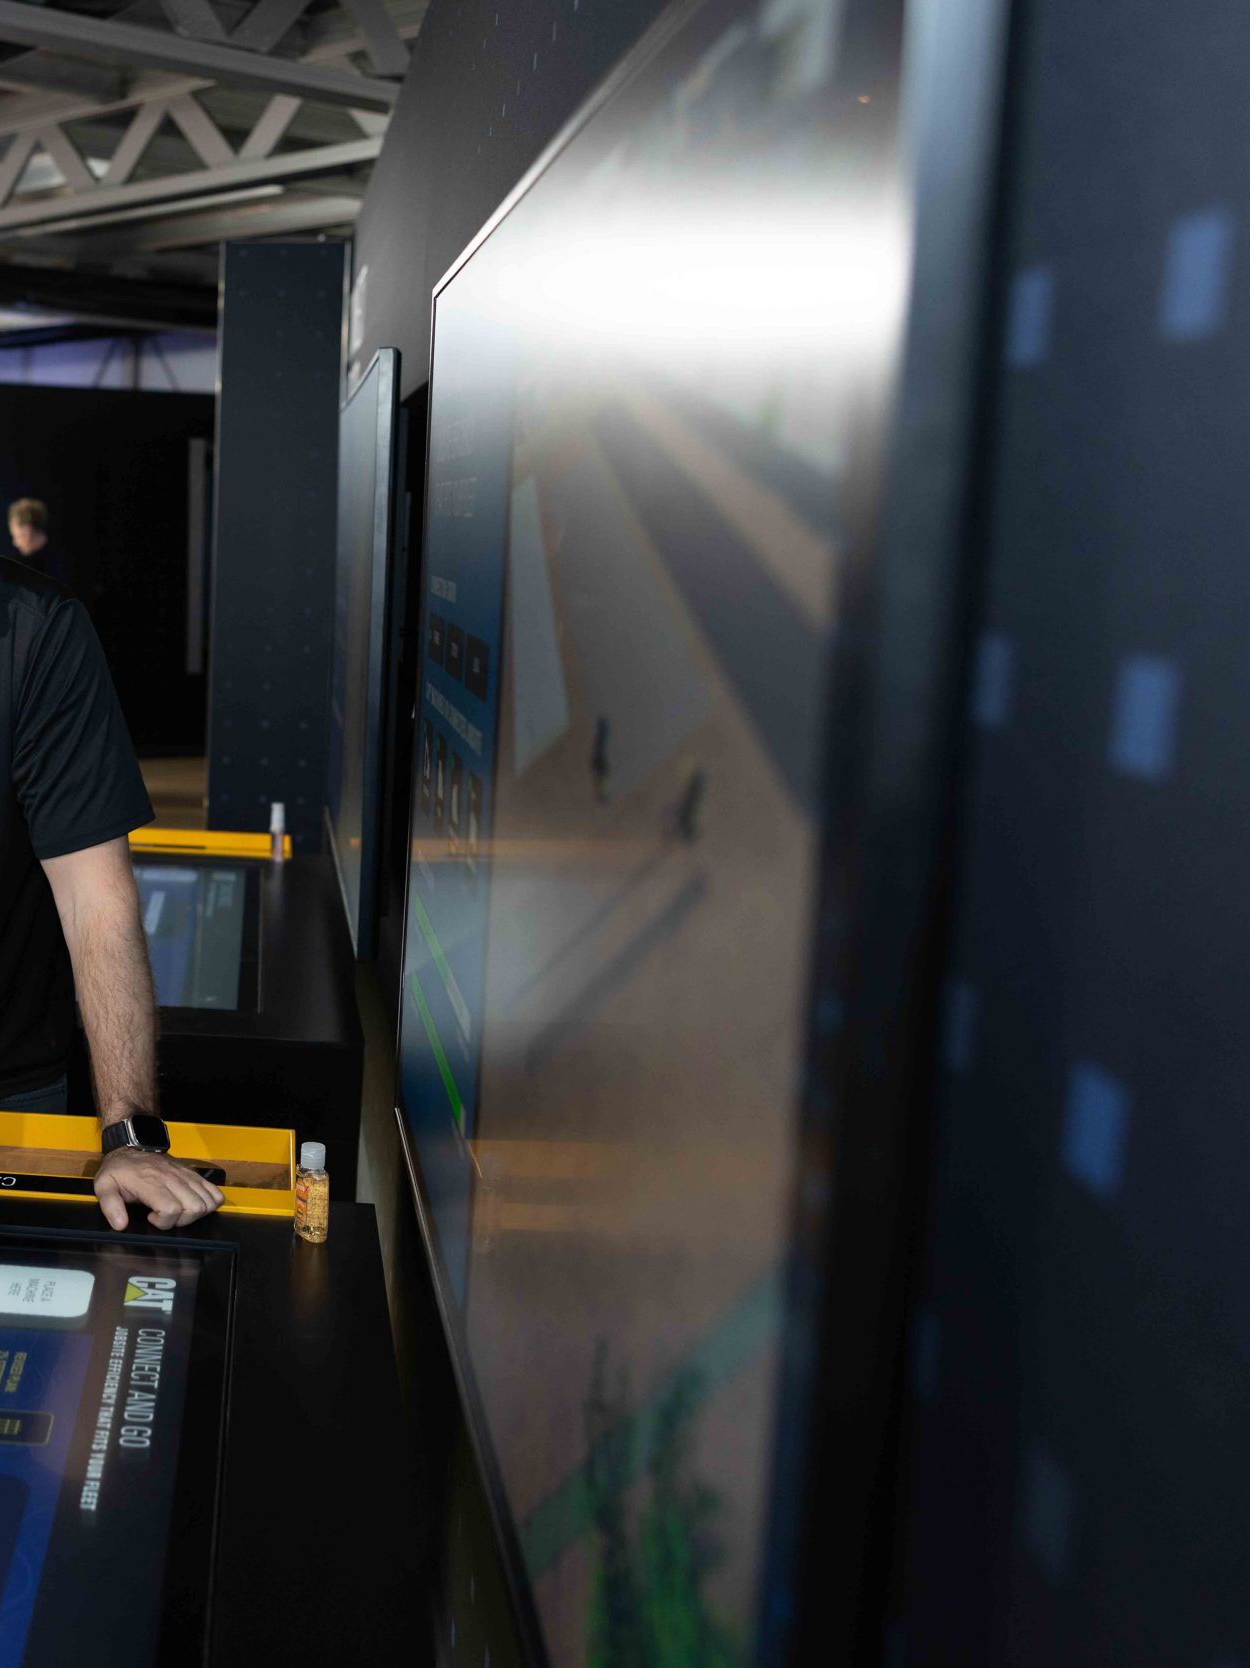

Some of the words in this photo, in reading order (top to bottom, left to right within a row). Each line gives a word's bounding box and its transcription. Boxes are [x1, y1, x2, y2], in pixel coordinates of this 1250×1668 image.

[123, 1276, 177, 1313] CAT
[110, 1325, 129, 1357] JOBSITE
[130, 1328, 166, 1389] CONNECT
[101, 1358, 123, 1405] EFFICIENCY
[95, 1406, 115, 1430] THAT
[124, 1389, 158, 1422] AND
[91, 1429, 110, 1451] FITS
[119, 1425, 152, 1449] GO
[85, 1452, 106, 1480] YOUR
[79, 1479, 101, 1512] FLEET
